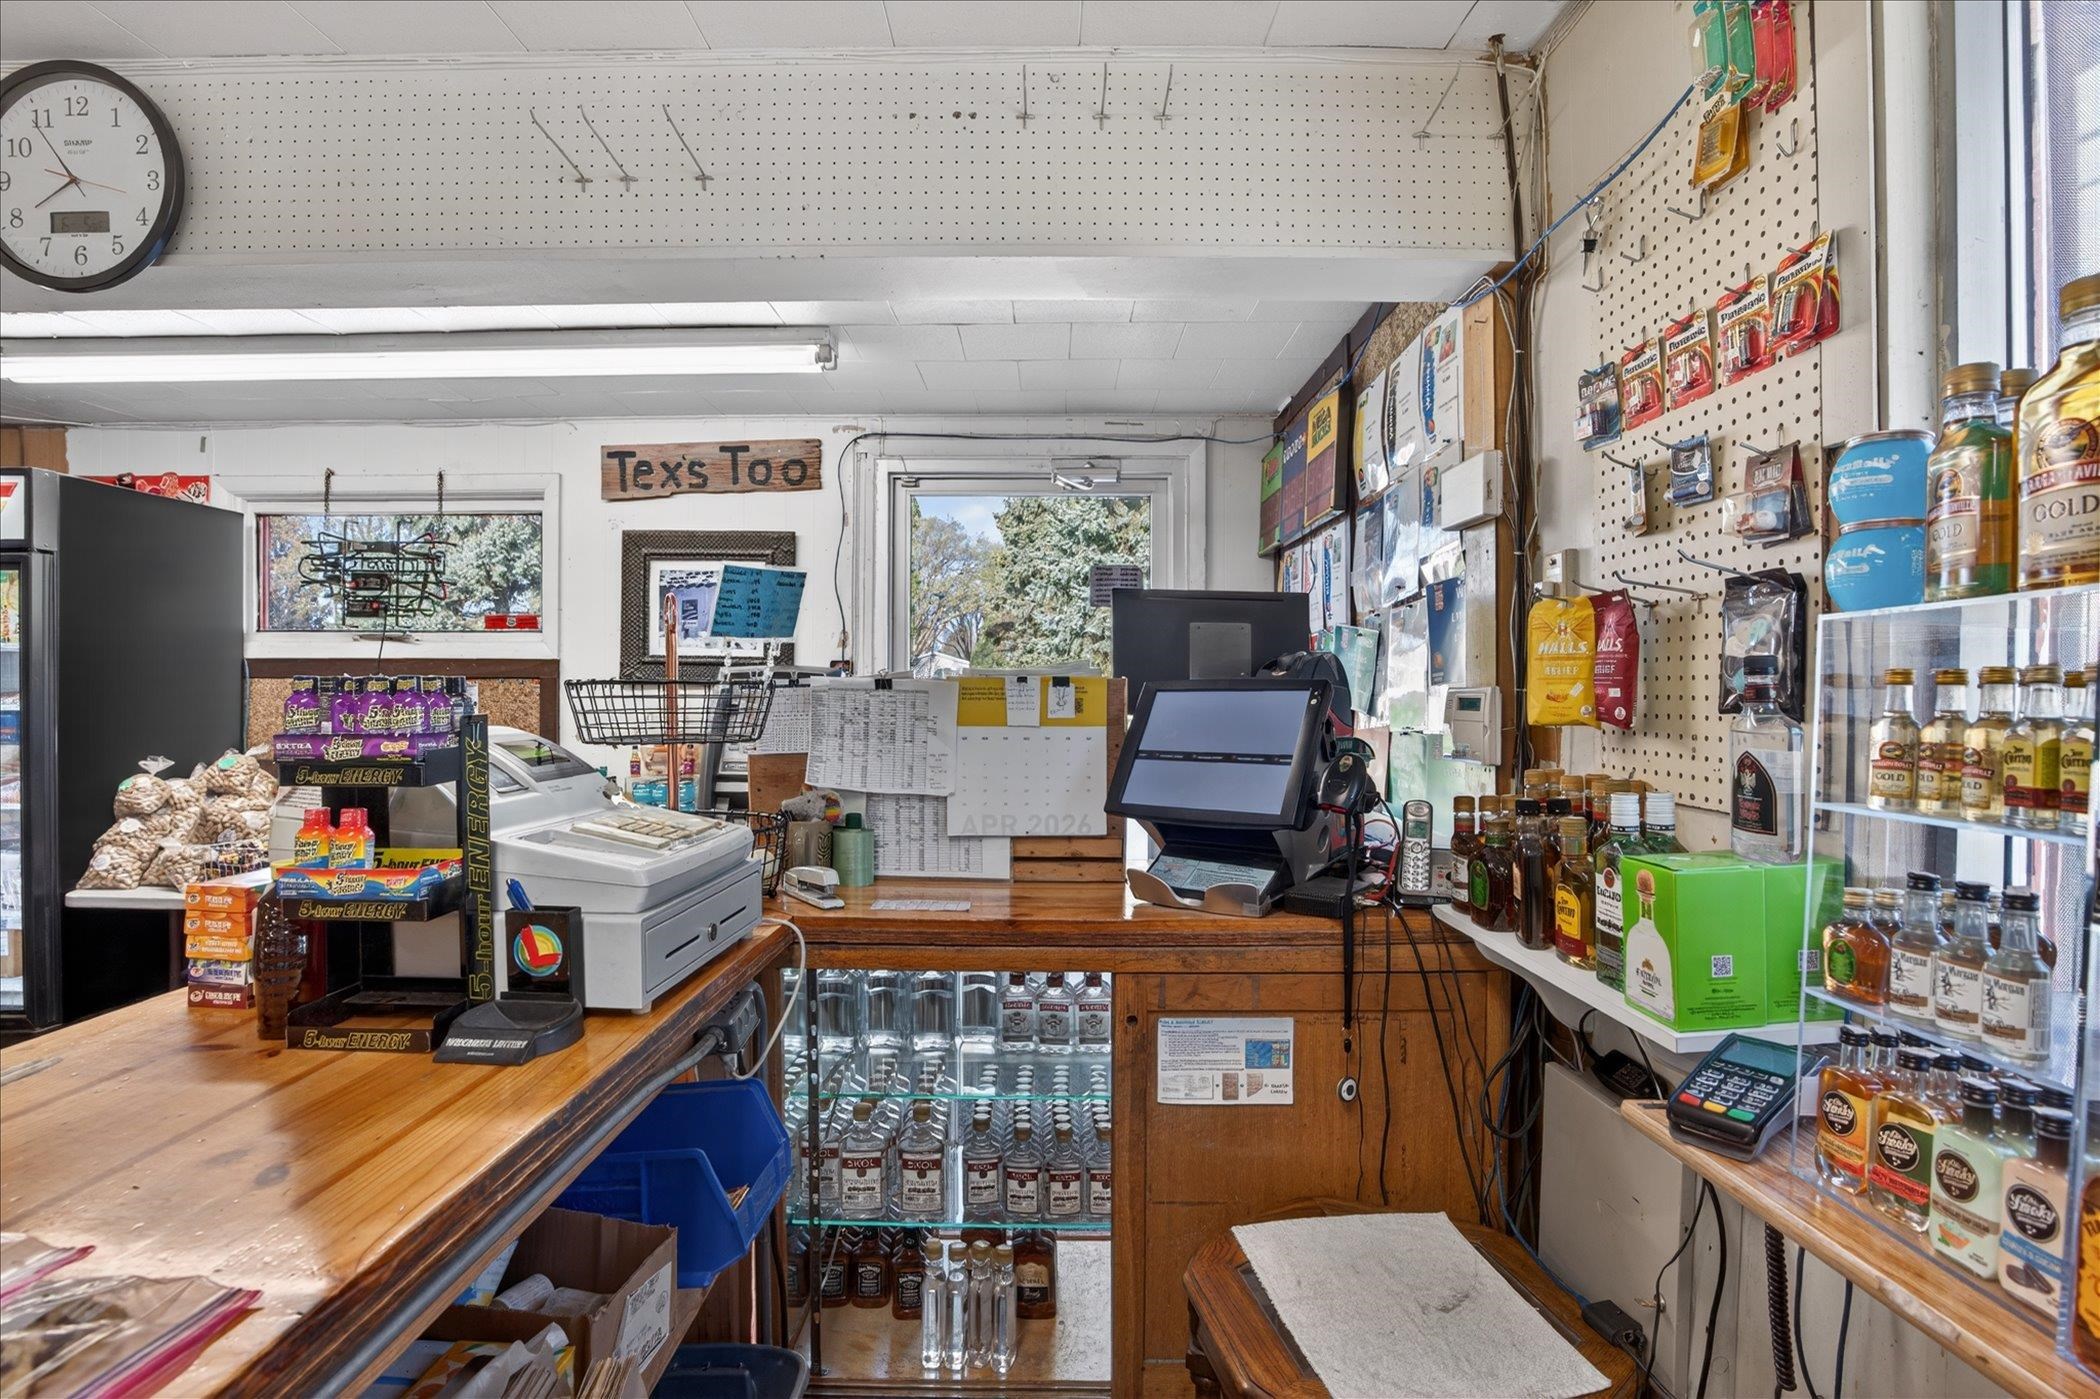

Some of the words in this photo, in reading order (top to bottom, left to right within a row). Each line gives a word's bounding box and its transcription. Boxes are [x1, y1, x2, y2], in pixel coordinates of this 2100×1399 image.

[64, 96, 89, 117] 12
[32, 109, 54, 128] 11
[111, 108, 122, 127] 1
[7, 137, 32, 158] 10
[136, 134, 149, 155] 2
[0, 171, 11, 192] 9
[147, 170, 160, 190] 3
[10, 208, 24, 228] 8
[136, 207, 149, 226] 4
[40, 237, 52, 256] 7
[112, 235, 125, 255] 5
[74, 246, 88, 265] 6
[607, 450, 709, 492] Tex's
[719, 445, 808, 487] Too
[2034, 495, 2100, 522] GOLD
[1538, 642, 1588, 655] HALLS
[295, 766, 339, 785] 5-hour
[340, 767, 405, 785] ENERGY
[1875, 773, 1905, 782] GOLD
[465, 736, 492, 892] ENERGY
[961, 814, 1017, 834] APR
[1028, 814, 1092, 834] 2026
[344, 902, 407, 919] ENERGY
[469, 893, 494, 1000] 5-hour
[348, 1033, 412, 1049] ENERGY
[1877, 1131, 1917, 1155] Smoky
[847, 1159, 875, 1167] SKOL
[907, 1161, 936, 1170] SKOL
[2010, 1194, 2057, 1226] Smoky
